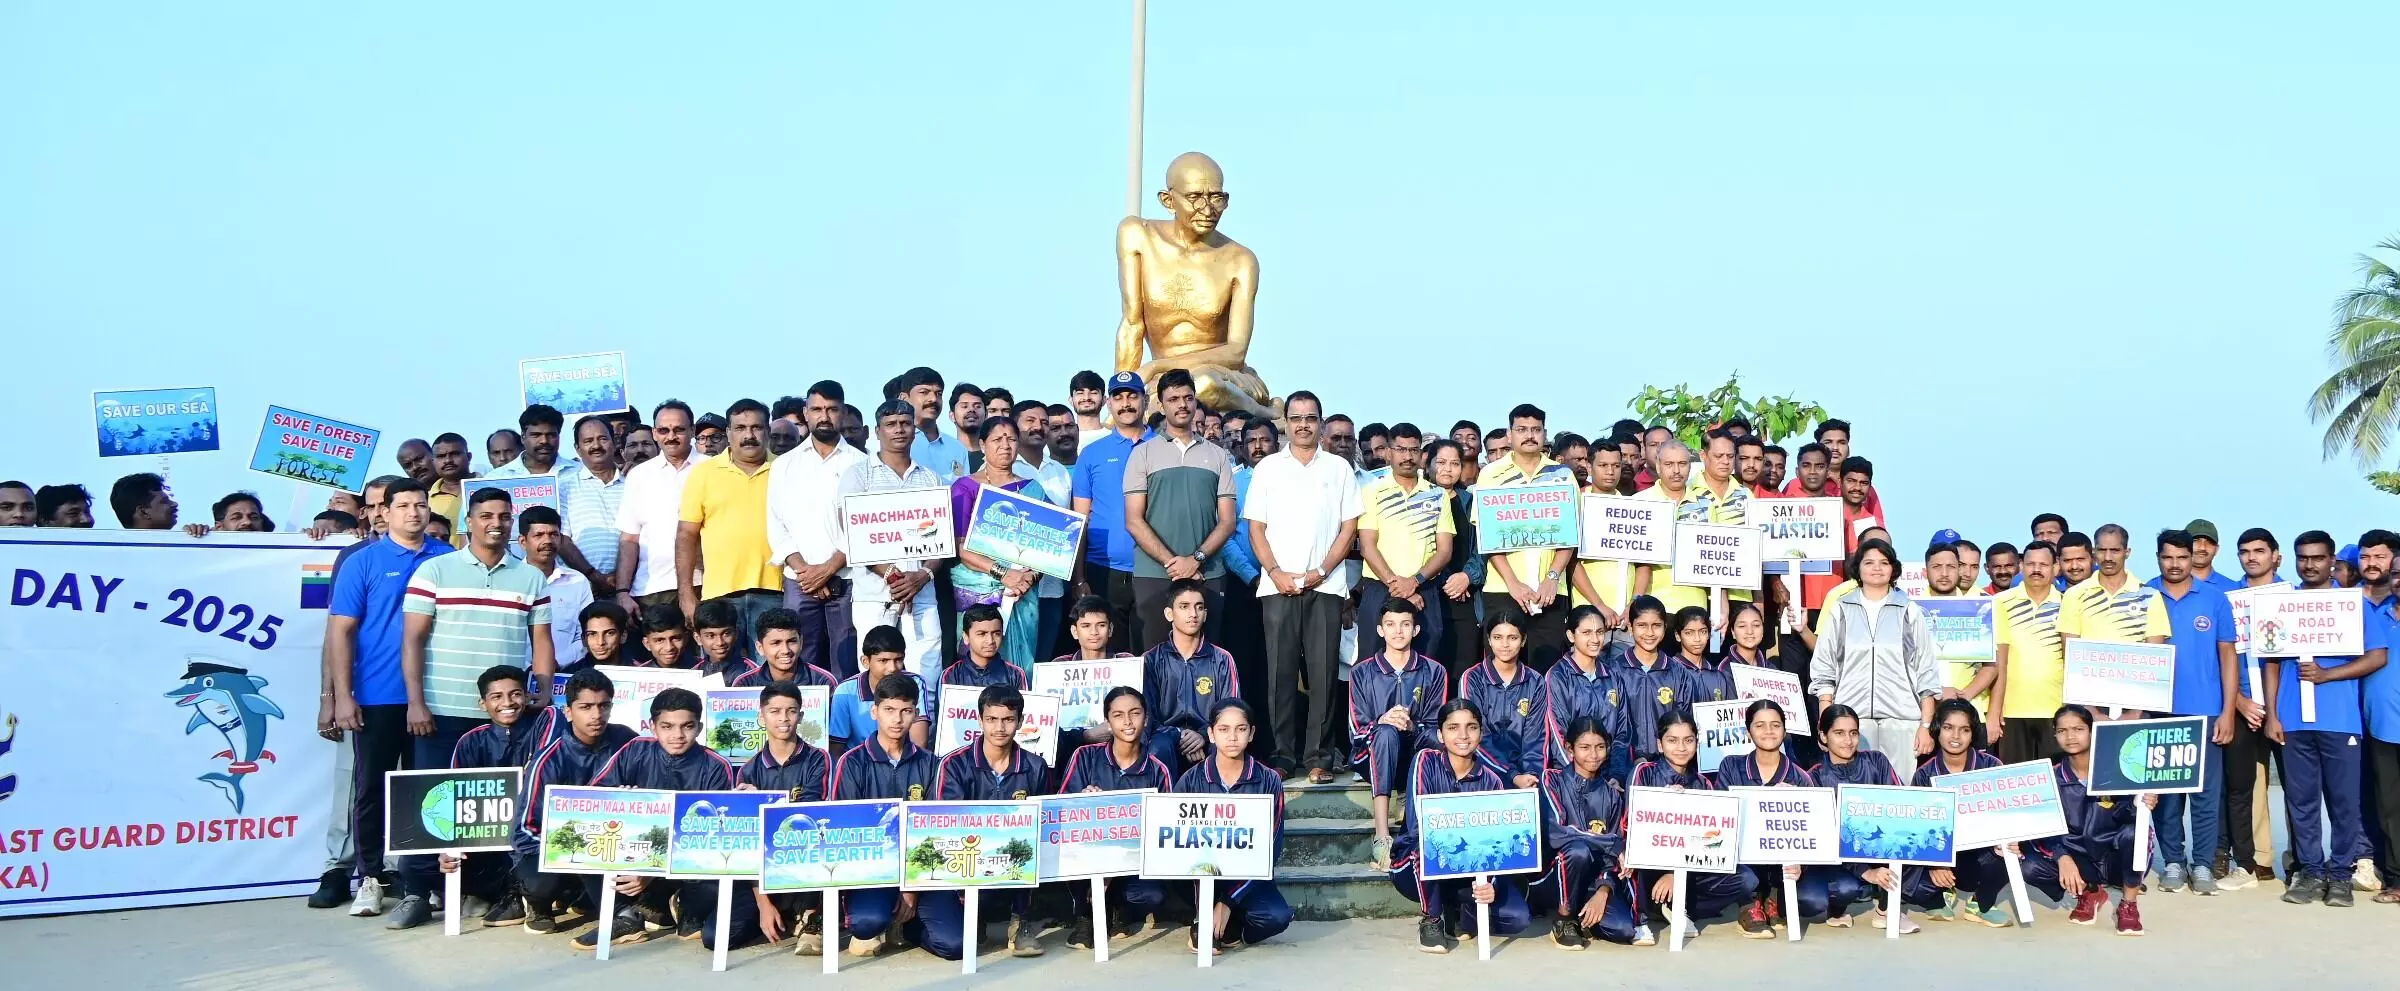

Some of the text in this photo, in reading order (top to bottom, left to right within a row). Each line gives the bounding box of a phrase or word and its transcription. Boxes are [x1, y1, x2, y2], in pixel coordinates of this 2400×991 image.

[529, 366, 616, 384] SAVE OUR SEA
[103, 400, 210, 419] SAVE OUR SEA
[272, 412, 371, 447] SAVE FOREST,
[281, 432, 354, 460] SAVE LIFE
[275, 456, 342, 484] FOREST
[514, 486, 552, 497] BEACH
[1483, 491, 1571, 506] SAVE FOREST,
[851, 507, 946, 525] SWACHHATA HI
[983, 508, 1020, 528] SAVE
[1496, 508, 1559, 520] SAVE LIFE
[1606, 508, 1651, 520] REDUCE
[1773, 505, 1814, 517] SAY NO
[1609, 524, 1646, 535] REUSE
[1759, 522, 1828, 539] PLASTIC!
[869, 532, 902, 544] SEVA
[980, 523, 1063, 556] SAVE EARTH
[1502, 532, 1557, 548] FOREST
[1601, 538, 1652, 551] RECYCLE
[1696, 535, 1739, 546] REDUCE
[1700, 551, 1735, 561] REUSE
[1693, 565, 1741, 576] RECYCLE
[11, 569, 284, 650] DAY - 2025
[2279, 601, 2356, 613] ADHERE TO
[2299, 618, 2335, 628] ROAD
[1938, 631, 1980, 641] EARTH
[2291, 633, 2343, 644] SAFETY
[2073, 649, 2166, 666] CLEAN BEACH
[1064, 667, 1110, 681] SAY NO
[2082, 667, 2156, 681] CLEAN SEA
[1753, 678, 1798, 693] ADHERE TO
[713, 701, 725, 711] EK
[728, 700, 752, 711] PEDH
[1040, 714, 1054, 726] HI
[1717, 708, 1733, 721] SAY
[2150, 728, 2191, 743] THERE
[2147, 744, 2197, 768] IS NO
[1997, 774, 2047, 791] BEACH
[2145, 769, 2191, 781] PLANET B
[456, 780, 505, 797] THERE
[456, 798, 513, 823] IS NO
[556, 800, 568, 811] EK
[573, 800, 600, 812] PEDH
[602, 801, 626, 813] MAA
[629, 802, 643, 814] KE
[1179, 803, 1235, 819] SAY NO
[1759, 801, 1809, 813] REDUCE
[1847, 802, 1948, 820] SAVE OUR SEA
[1958, 794, 2041, 814] CLEAN SEA
[913, 814, 1032, 828] EK PEDH MAA KE NAAM
[1041, 805, 1141, 824] CLEAN BEAC
[1428, 809, 1530, 829] SAVE OUR SEA
[1636, 810, 1734, 828] SWACHHATA HI
[680, 816, 719, 832] SAVE
[1766, 819, 1807, 831] REUSE
[53, 823, 165, 851] GUARD
[176, 815, 299, 844] DISTRICT
[456, 825, 508, 839] PLANET B
[773, 829, 820, 847] SAVE
[1049, 825, 1140, 844] CLEAN SEA
[1159, 826, 1254, 849] PLASTIC!
[680, 835, 760, 849] SAVE EART
[1652, 835, 1685, 848] SEVA
[1760, 838, 1816, 850] RECYCLE
[774, 846, 884, 865] SAVE EARTH
[945, 835, 981, 877] माँ
[988, 855, 1008, 867] नाम
